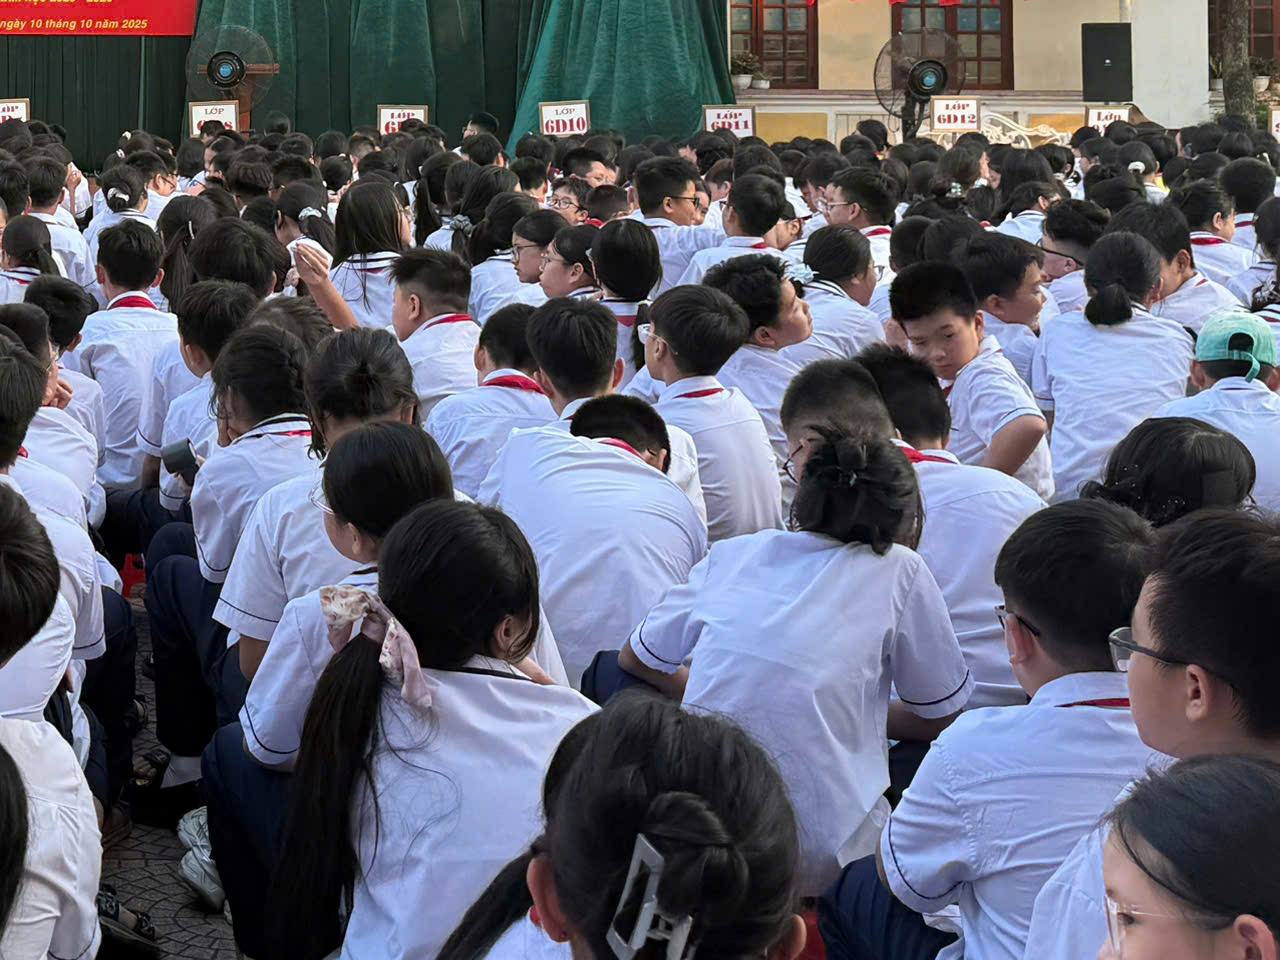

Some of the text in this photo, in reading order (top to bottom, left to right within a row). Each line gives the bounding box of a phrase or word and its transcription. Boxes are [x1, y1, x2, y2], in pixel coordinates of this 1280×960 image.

[0, 20, 26, 30] ngày
[30, 20, 42, 28] 10
[45, 19, 76, 30] tháng
[80, 20, 92, 28] 10
[95, 19, 119, 28] năm
[122, 20, 148, 28] 2025
[945, 100, 970, 110] LỚP
[204, 106, 224, 115] LỚP
[555, 107, 575, 116] LỚP
[717, 110, 742, 119] LỚP
[937, 114, 976, 124] 6D12
[545, 117, 586, 134] 6D10
[711, 120, 750, 131] 6D11
